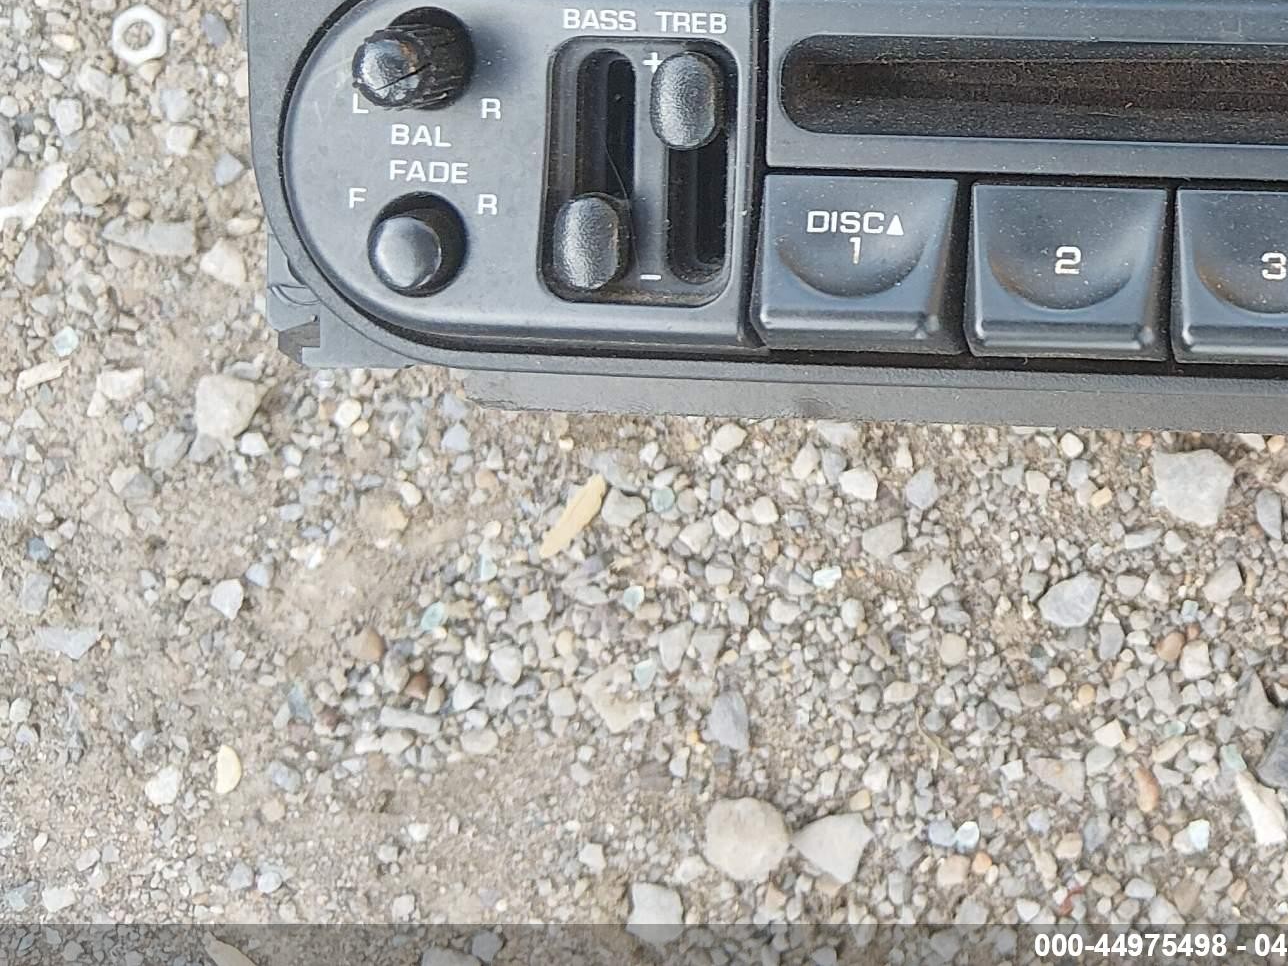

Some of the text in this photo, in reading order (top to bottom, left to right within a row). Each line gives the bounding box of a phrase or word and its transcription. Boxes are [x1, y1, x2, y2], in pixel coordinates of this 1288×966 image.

[562, 8, 728, 34] BASS TREB
[481, 98, 501, 120] R
[391, 123, 452, 147] BAL
[389, 159, 469, 184] FADE
[349, 187, 367, 209] F
[477, 193, 498, 215] R
[806, 210, 885, 234] DISC
[849, 236, 861, 264] 1
[1054, 246, 1082, 275] 2
[1261, 252, 1287, 280] 3
